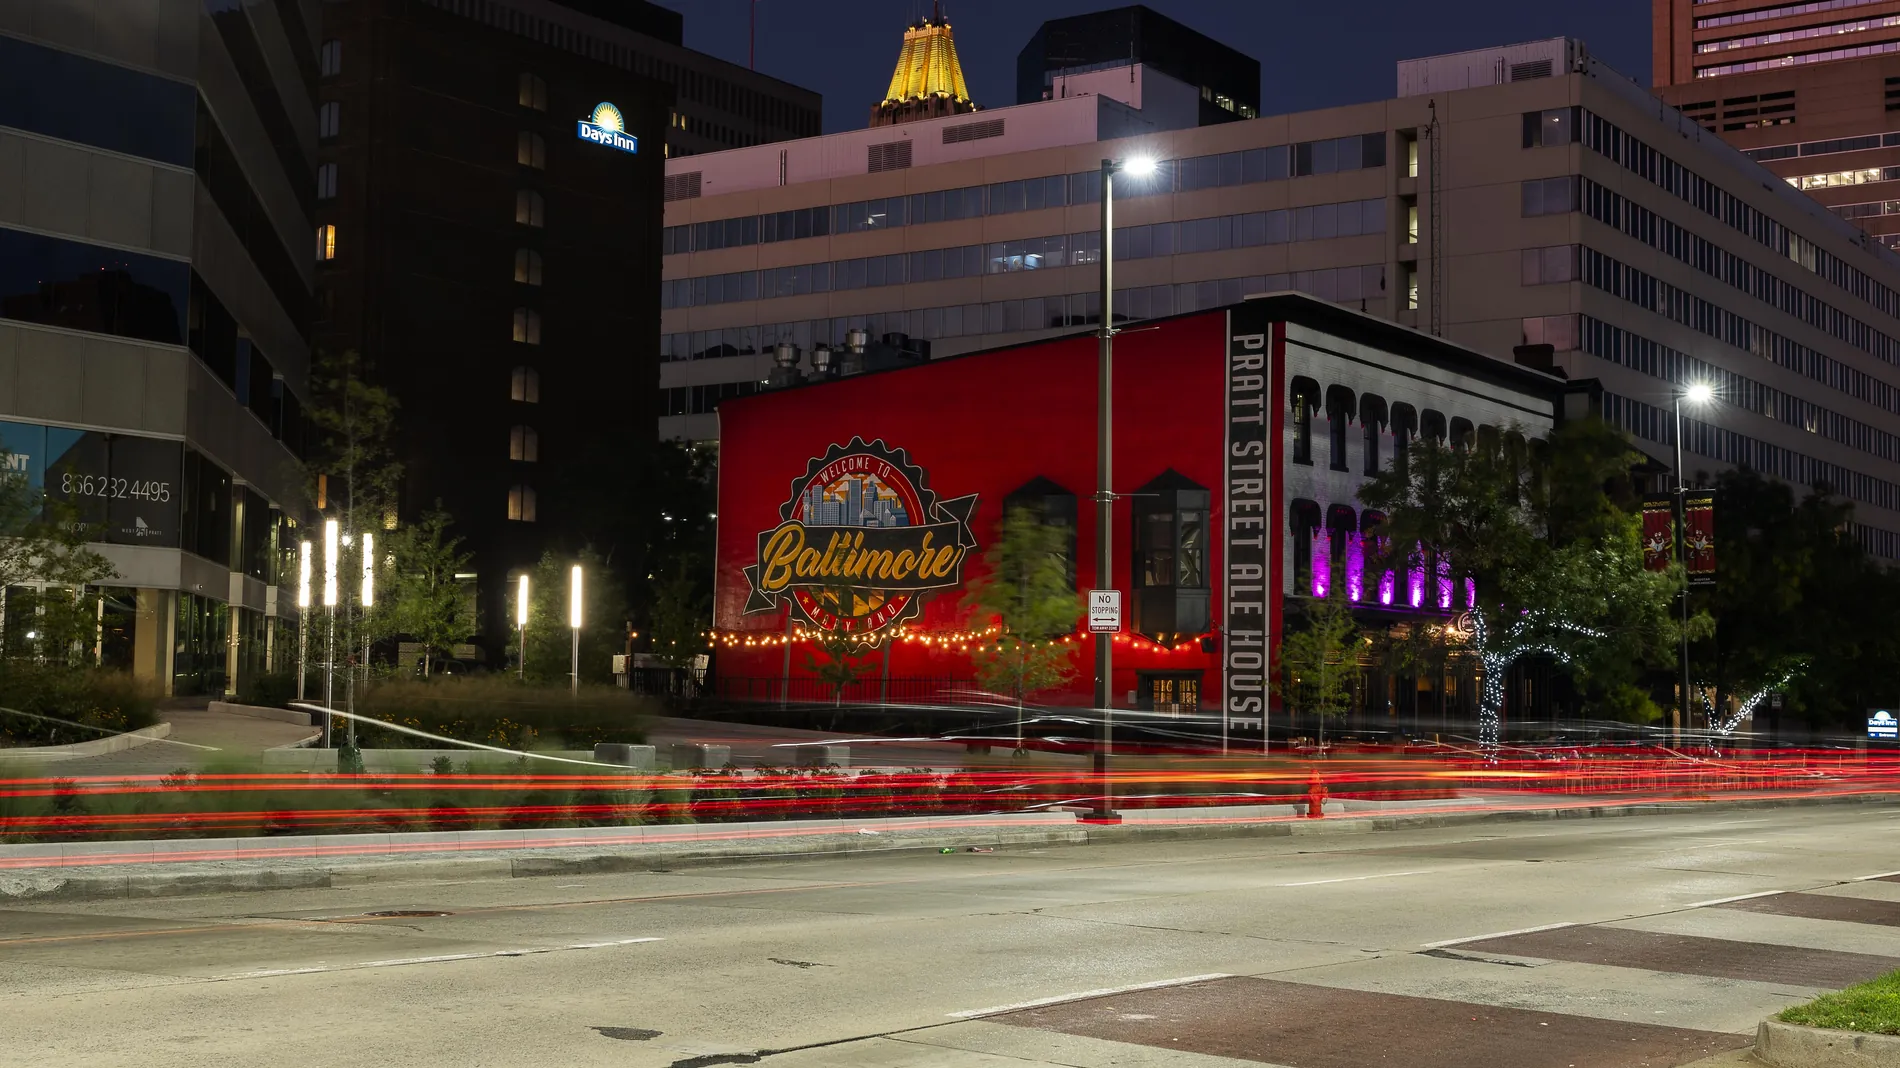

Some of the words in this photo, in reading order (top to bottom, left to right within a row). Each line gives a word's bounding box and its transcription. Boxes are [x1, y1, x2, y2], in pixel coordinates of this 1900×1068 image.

[581, 124, 612, 144] Days
[613, 133, 634, 151] Inn
[1231, 333, 1264, 425] PRATT
[820, 457, 869, 483] WELCOME
[877, 462, 891, 478] TO
[62, 473, 170, 503] 866.232.4495
[1230, 440, 1264, 549] STREET
[762, 524, 962, 589] Baltimore
[1098, 595, 1111, 604] NO
[1230, 563, 1263, 614] ALE
[810, 603, 896, 632] MARYAND
[1092, 606, 1118, 614] STOPPING
[1229, 629, 1262, 730] HOUSE
